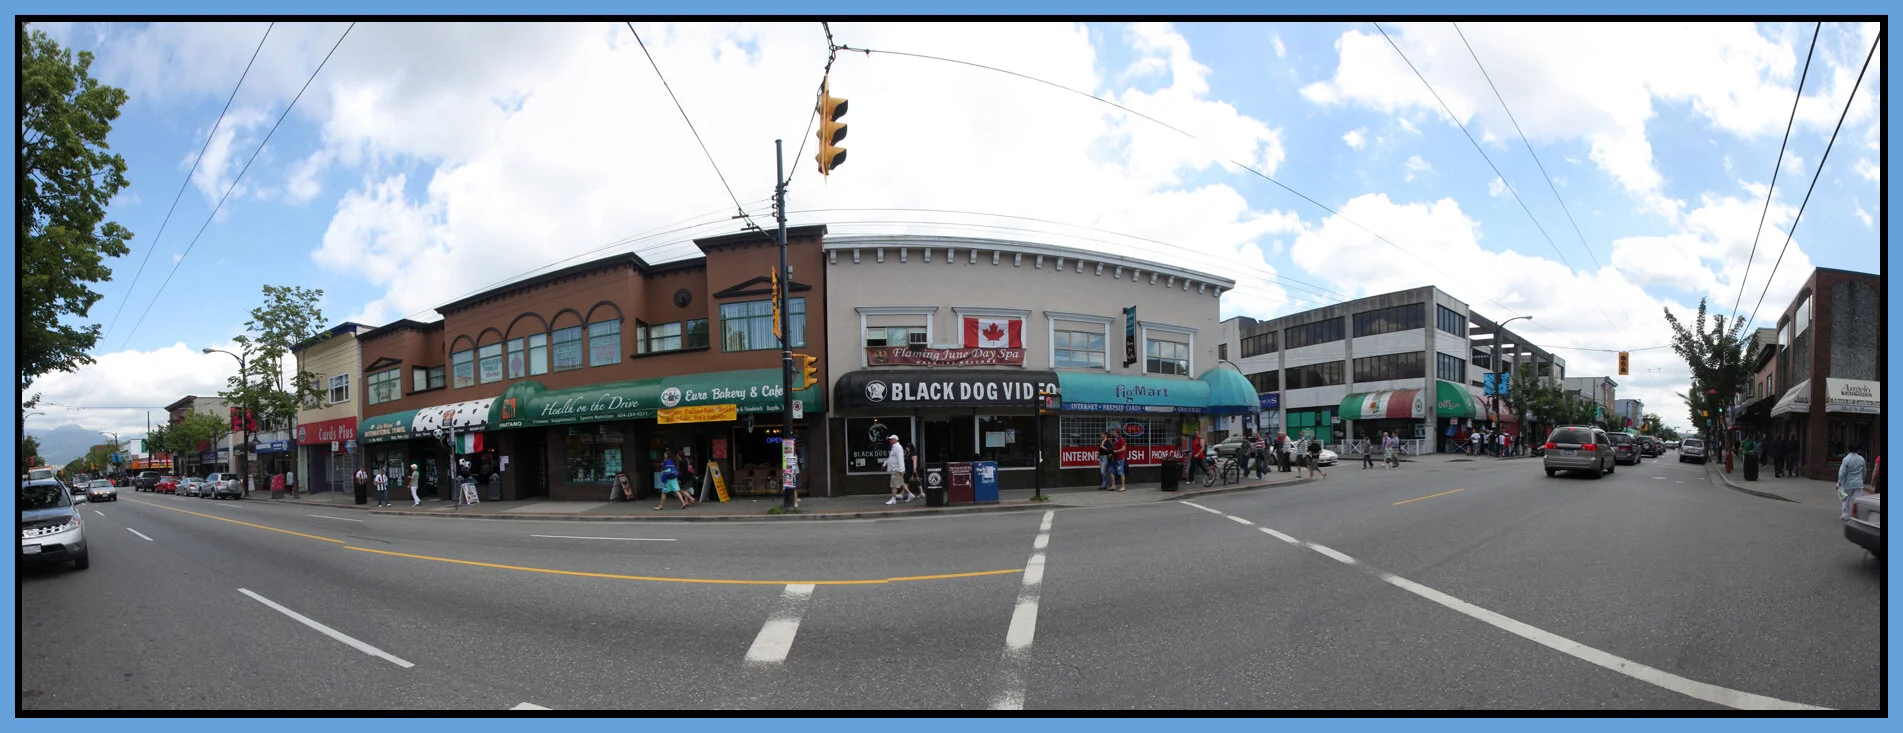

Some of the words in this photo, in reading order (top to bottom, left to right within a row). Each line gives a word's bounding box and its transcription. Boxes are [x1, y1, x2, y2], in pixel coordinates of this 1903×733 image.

[892, 348, 939, 361] Flaming
[941, 349, 968, 360] June
[972, 348, 995, 358] Day
[997, 348, 1019, 360] Spa
[685, 389, 708, 402] Euro
[712, 387, 747, 401] Bakery
[750, 386, 758, 398] &
[891, 382, 955, 401] BLACK
[960, 382, 998, 401] DOG
[1841, 383, 1871, 393] Angelo
[541, 396, 580, 417] Health
[577, 405, 587, 413] on
[590, 394, 609, 412] the
[608, 396, 639, 410] Drive
[319, 426, 337, 441] Cards
[338, 424, 353, 440] Plus
[1151, 450, 1169, 460] PHONE
